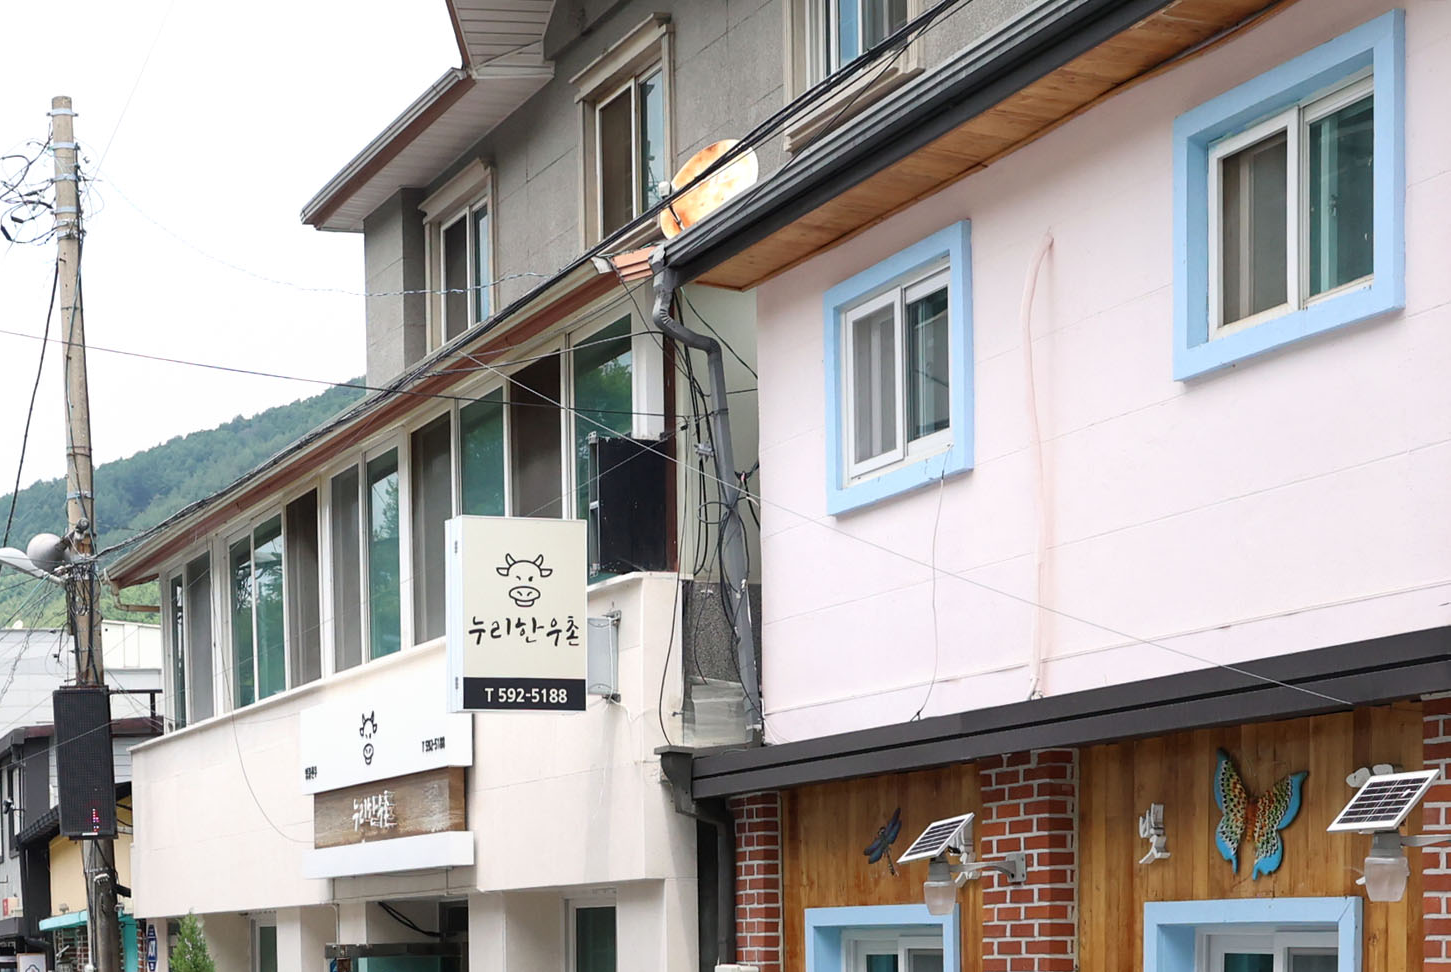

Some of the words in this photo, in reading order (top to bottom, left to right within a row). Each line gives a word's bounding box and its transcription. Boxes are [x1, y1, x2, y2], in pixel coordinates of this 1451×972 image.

[468, 615, 580, 647] 누리한우촌
[484, 687, 495, 703] T
[498, 687, 568, 703] 592-5188
